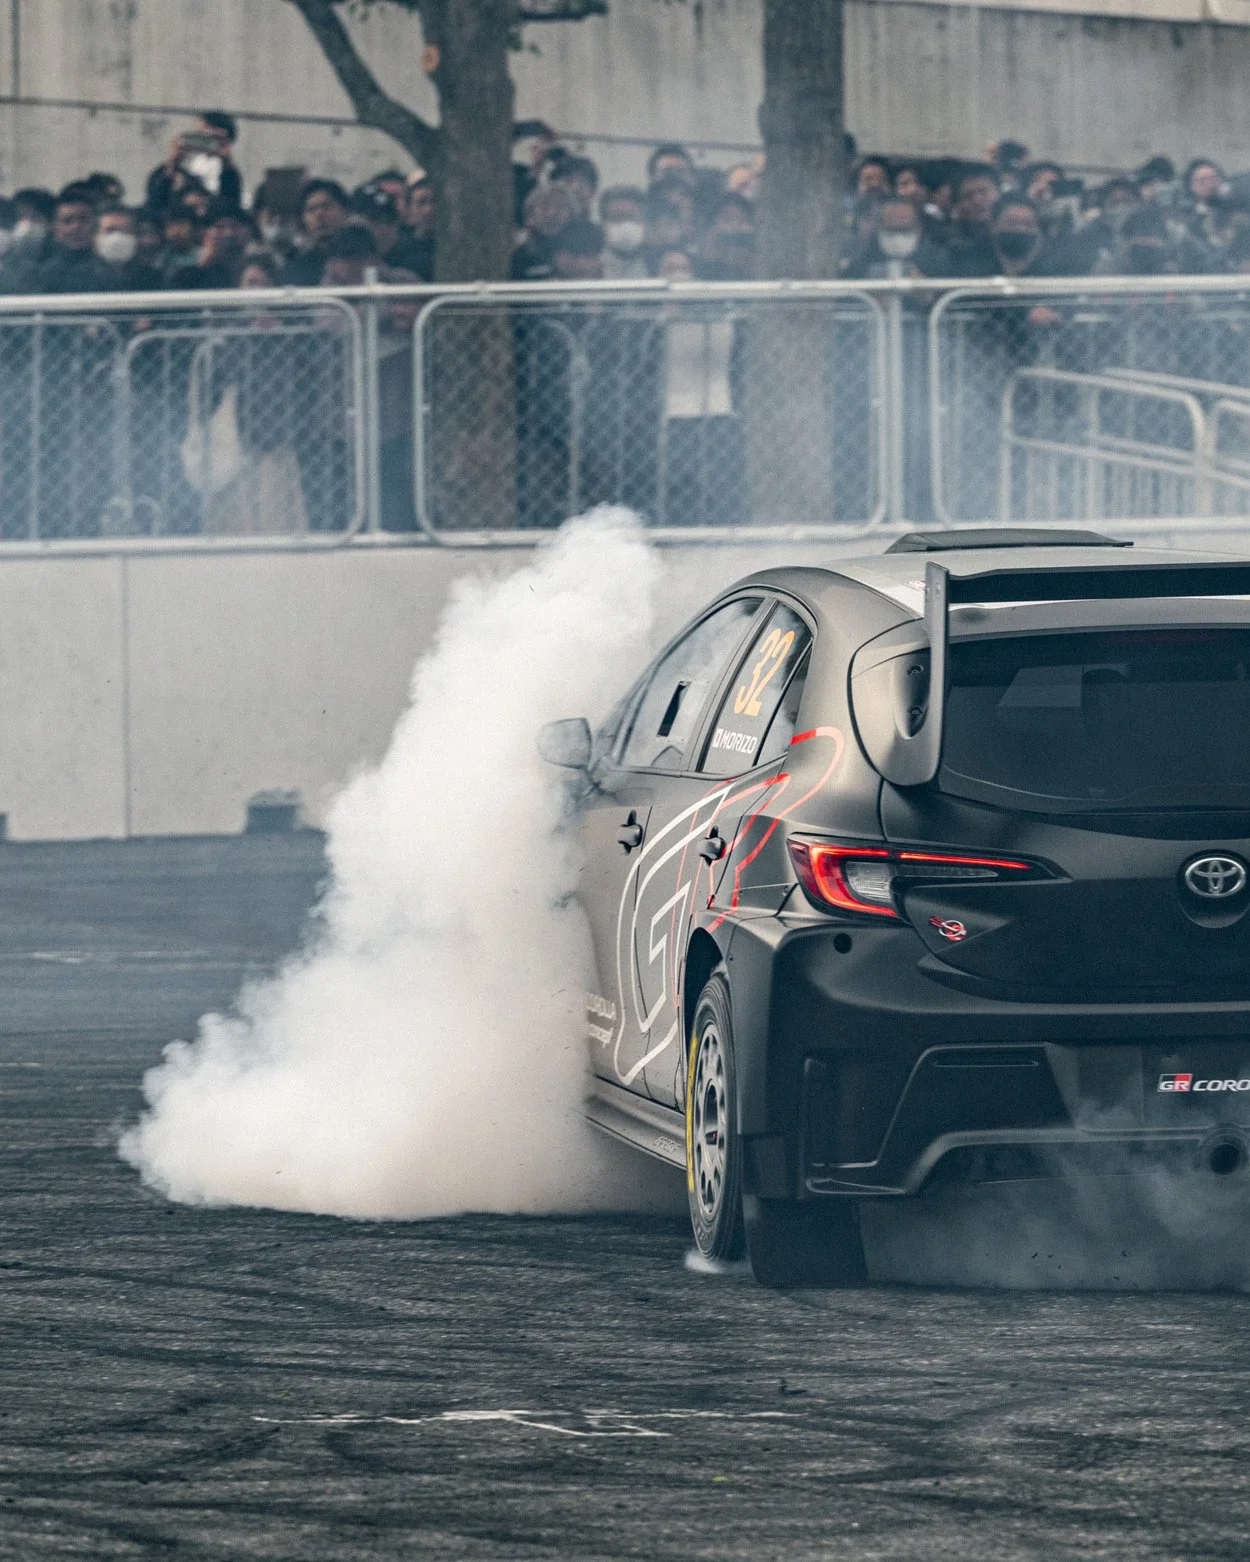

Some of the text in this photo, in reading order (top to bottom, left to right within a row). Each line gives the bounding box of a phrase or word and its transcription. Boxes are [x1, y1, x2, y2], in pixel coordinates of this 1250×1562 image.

[734, 628, 795, 717] 32
[719, 730, 758, 754] MORIZO
[1158, 1079, 1190, 1091] GR
